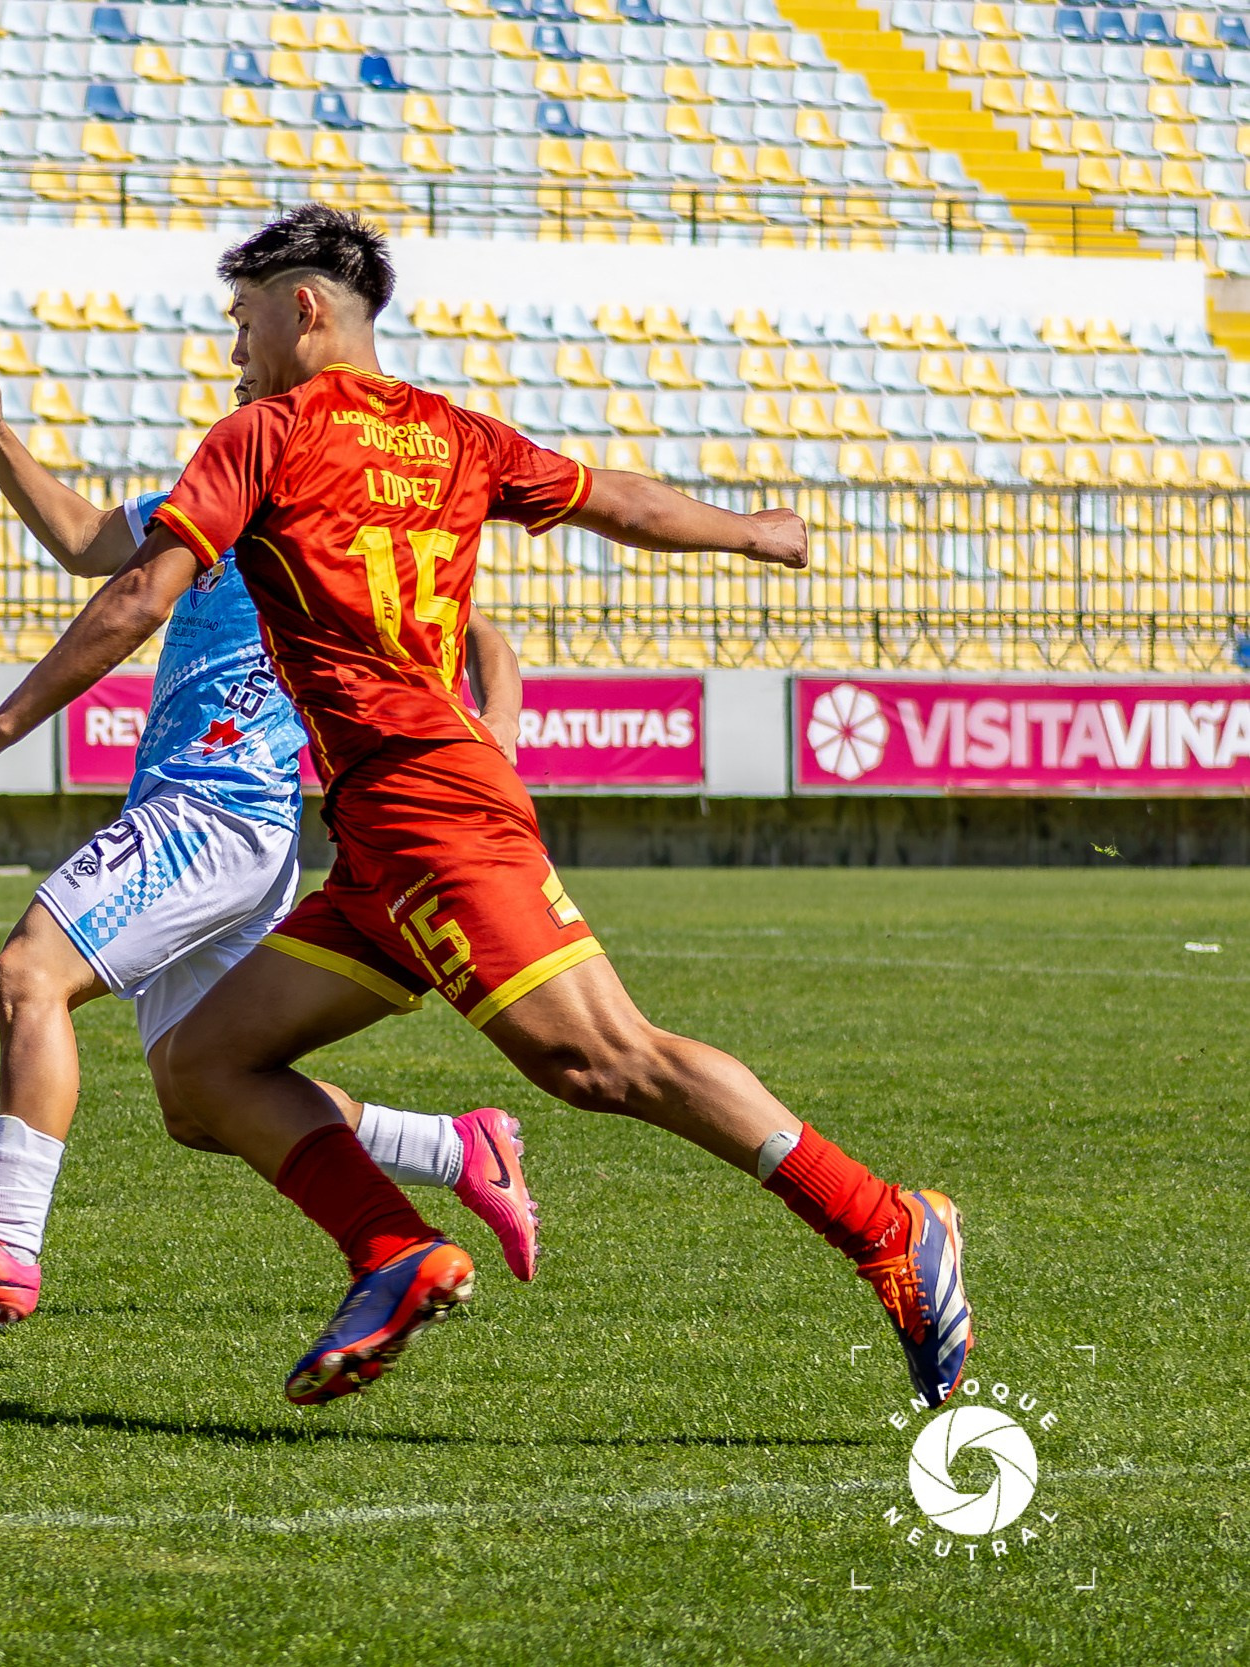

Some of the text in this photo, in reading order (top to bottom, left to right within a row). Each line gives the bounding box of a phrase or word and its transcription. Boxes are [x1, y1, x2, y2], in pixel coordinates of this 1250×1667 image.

[357, 424, 449, 460] JUANITO
[364, 468, 444, 511] LOPEZ
[345, 525, 460, 697] 15
[517, 708, 695, 749] RATUITAS
[400, 894, 470, 985] 15
